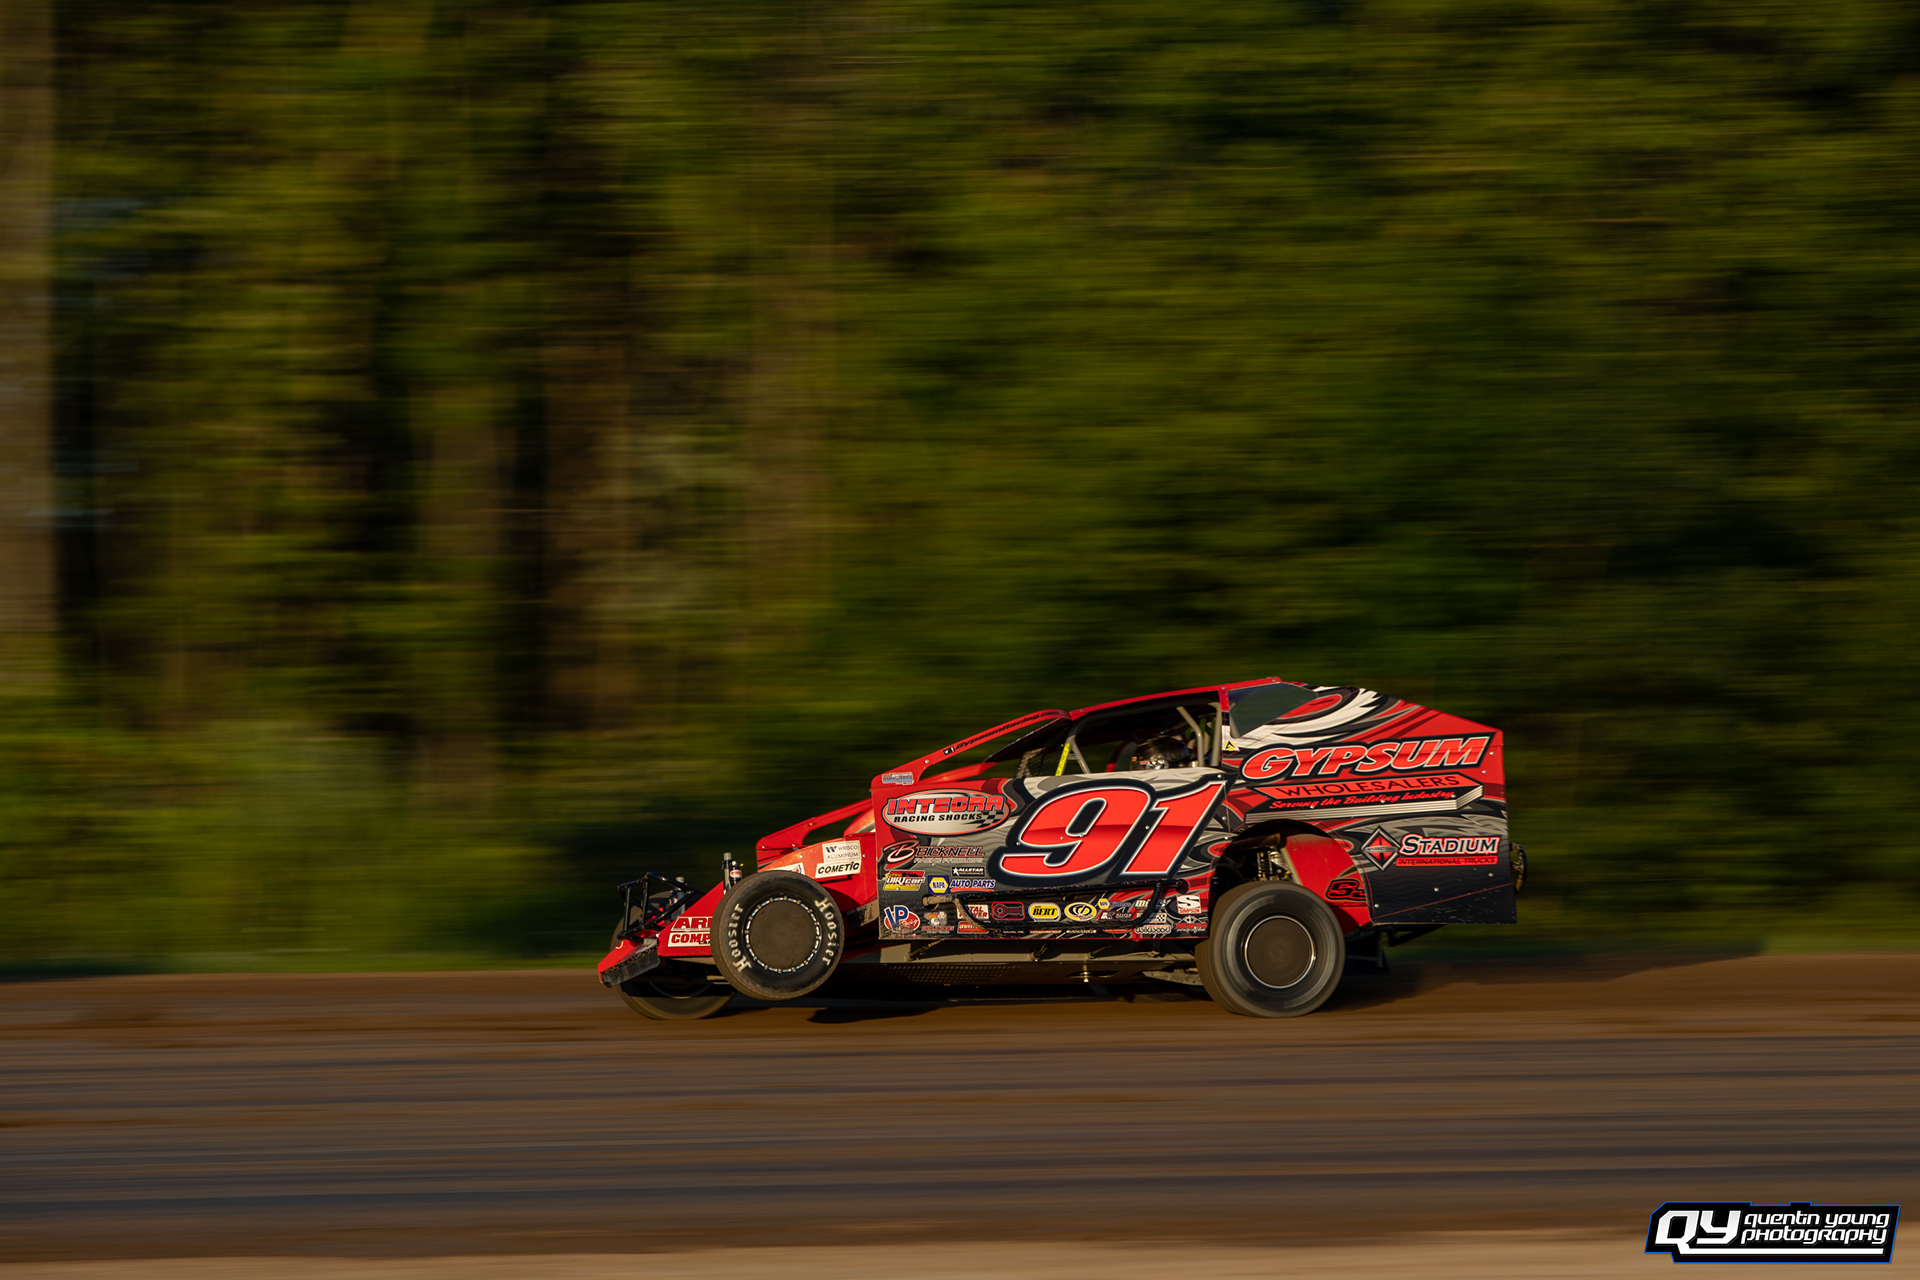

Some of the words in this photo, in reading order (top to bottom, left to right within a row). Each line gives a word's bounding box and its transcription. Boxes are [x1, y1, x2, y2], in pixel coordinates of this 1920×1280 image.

[1242, 735, 1491, 781] GYPSUM
[1276, 776, 1461, 797] WHOLESALERS
[887, 795, 1004, 815] INTEGRA
[1269, 799, 1319, 810] Serving
[1320, 797, 1341, 807] the
[1344, 792, 1400, 806] Building
[1401, 790, 1456, 802] Industry
[893, 814, 935, 823] RACING
[938, 813, 983, 821] SHOCKS
[999, 781, 1226, 877] 91
[1401, 834, 1499, 855] STADIUM
[827, 852, 859, 860] ALUMINUM
[915, 845, 985, 858] BICKNELL
[1398, 856, 1461, 866] INTERNATIONAL
[1464, 855, 1496, 864] TRUCKS
[818, 861, 860, 874] COMETIC
[932, 881, 946, 889] NAPA
[951, 879, 971, 888] AUTO
[972, 879, 995, 888] PARTS
[883, 905, 909, 932] VP
[1032, 908, 1057, 916] BERT
[673, 917, 713, 929] AR
